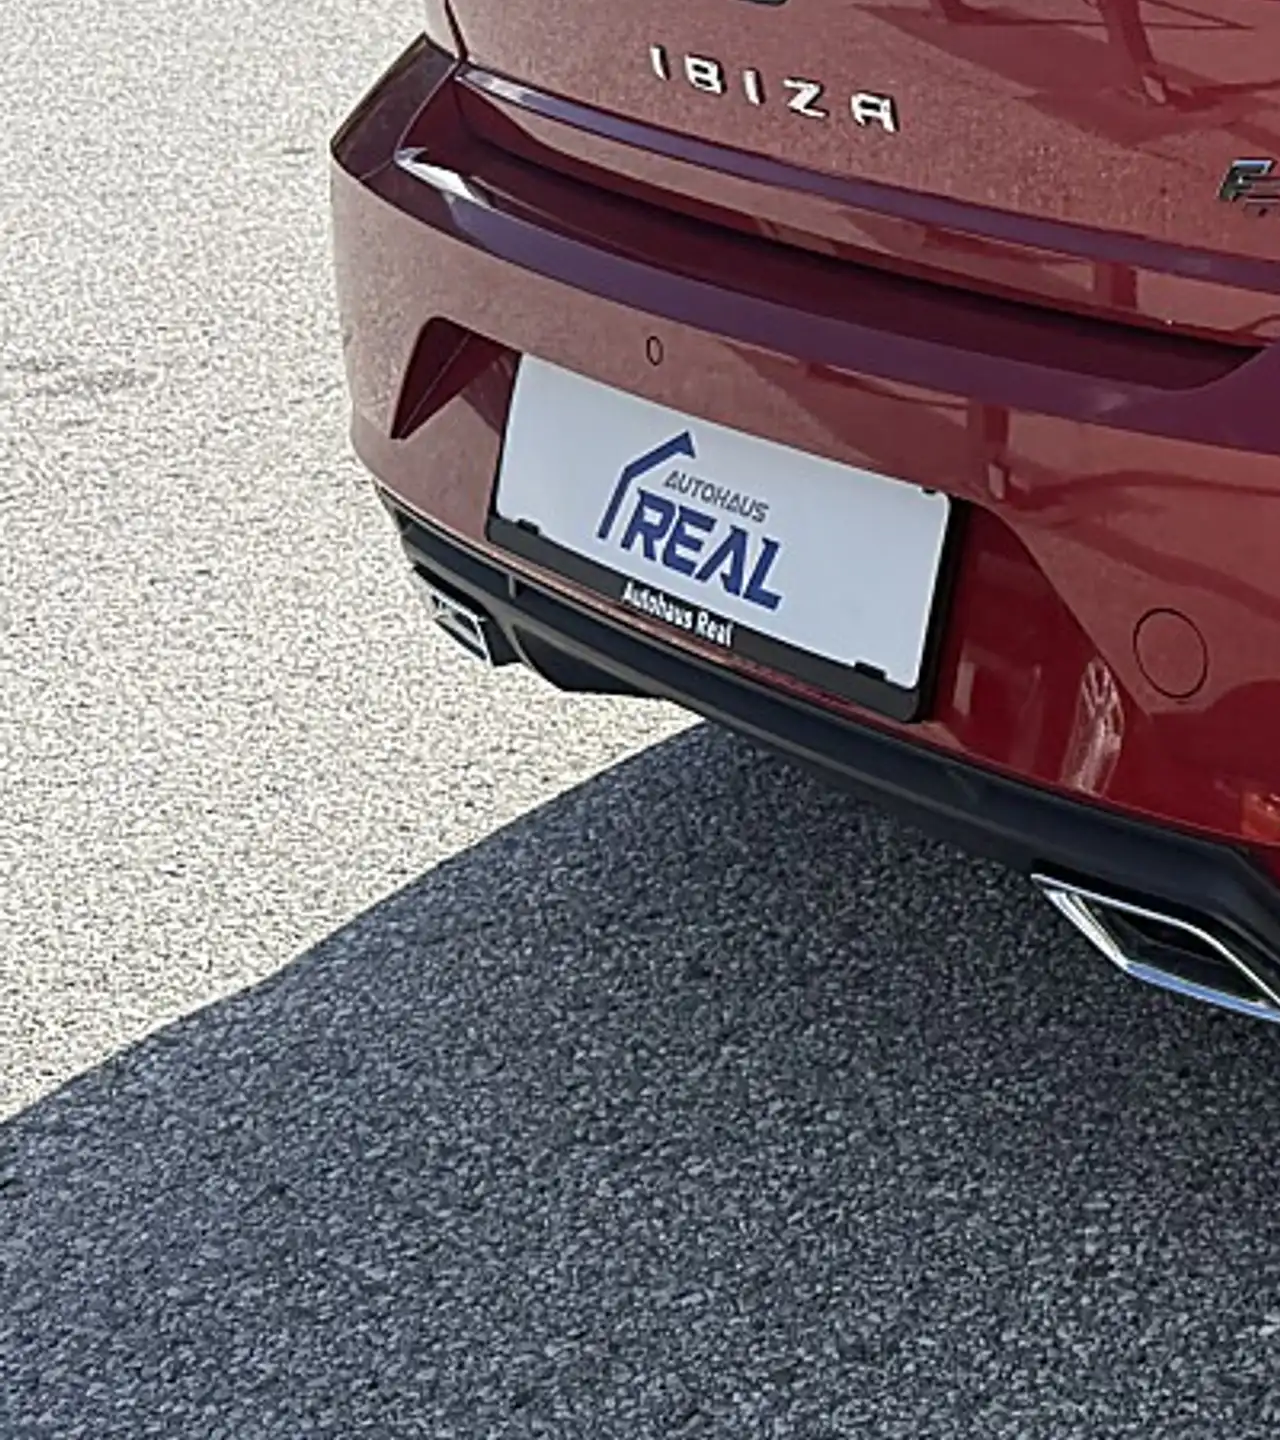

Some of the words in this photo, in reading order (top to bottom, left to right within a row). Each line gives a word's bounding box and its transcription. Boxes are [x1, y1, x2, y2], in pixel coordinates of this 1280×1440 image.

[650, 45, 898, 133] IBIZA
[663, 470, 770, 523] AUTOHAUS
[621, 487, 783, 612] REAL
[622, 581, 694, 630] Autohaus
[695, 610, 734, 647] Real
